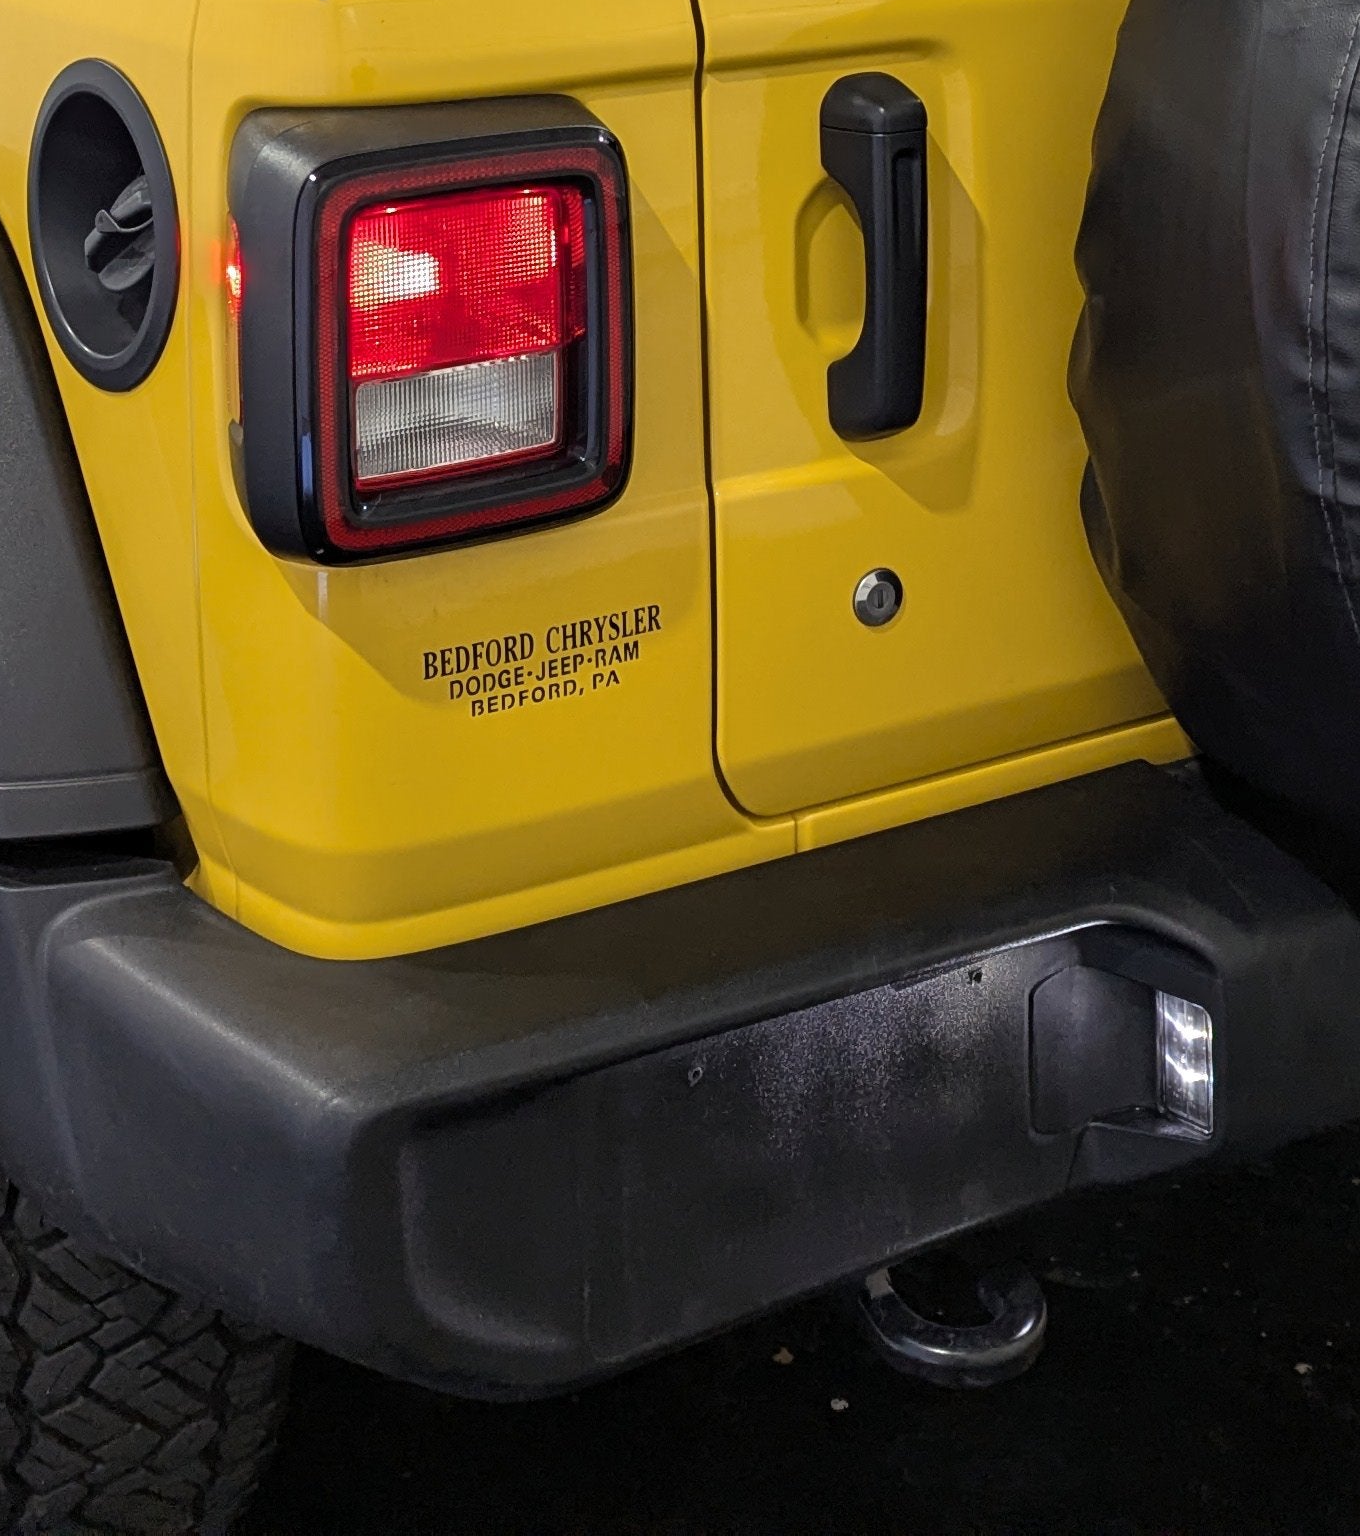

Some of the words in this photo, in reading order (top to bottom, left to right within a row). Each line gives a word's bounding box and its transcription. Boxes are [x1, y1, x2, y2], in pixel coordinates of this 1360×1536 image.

[422, 632, 535, 681] BEDFORD
[545, 604, 662, 654] CHRYSLER
[471, 679, 585, 717] BEDFORD,
[592, 669, 621, 690] PA
